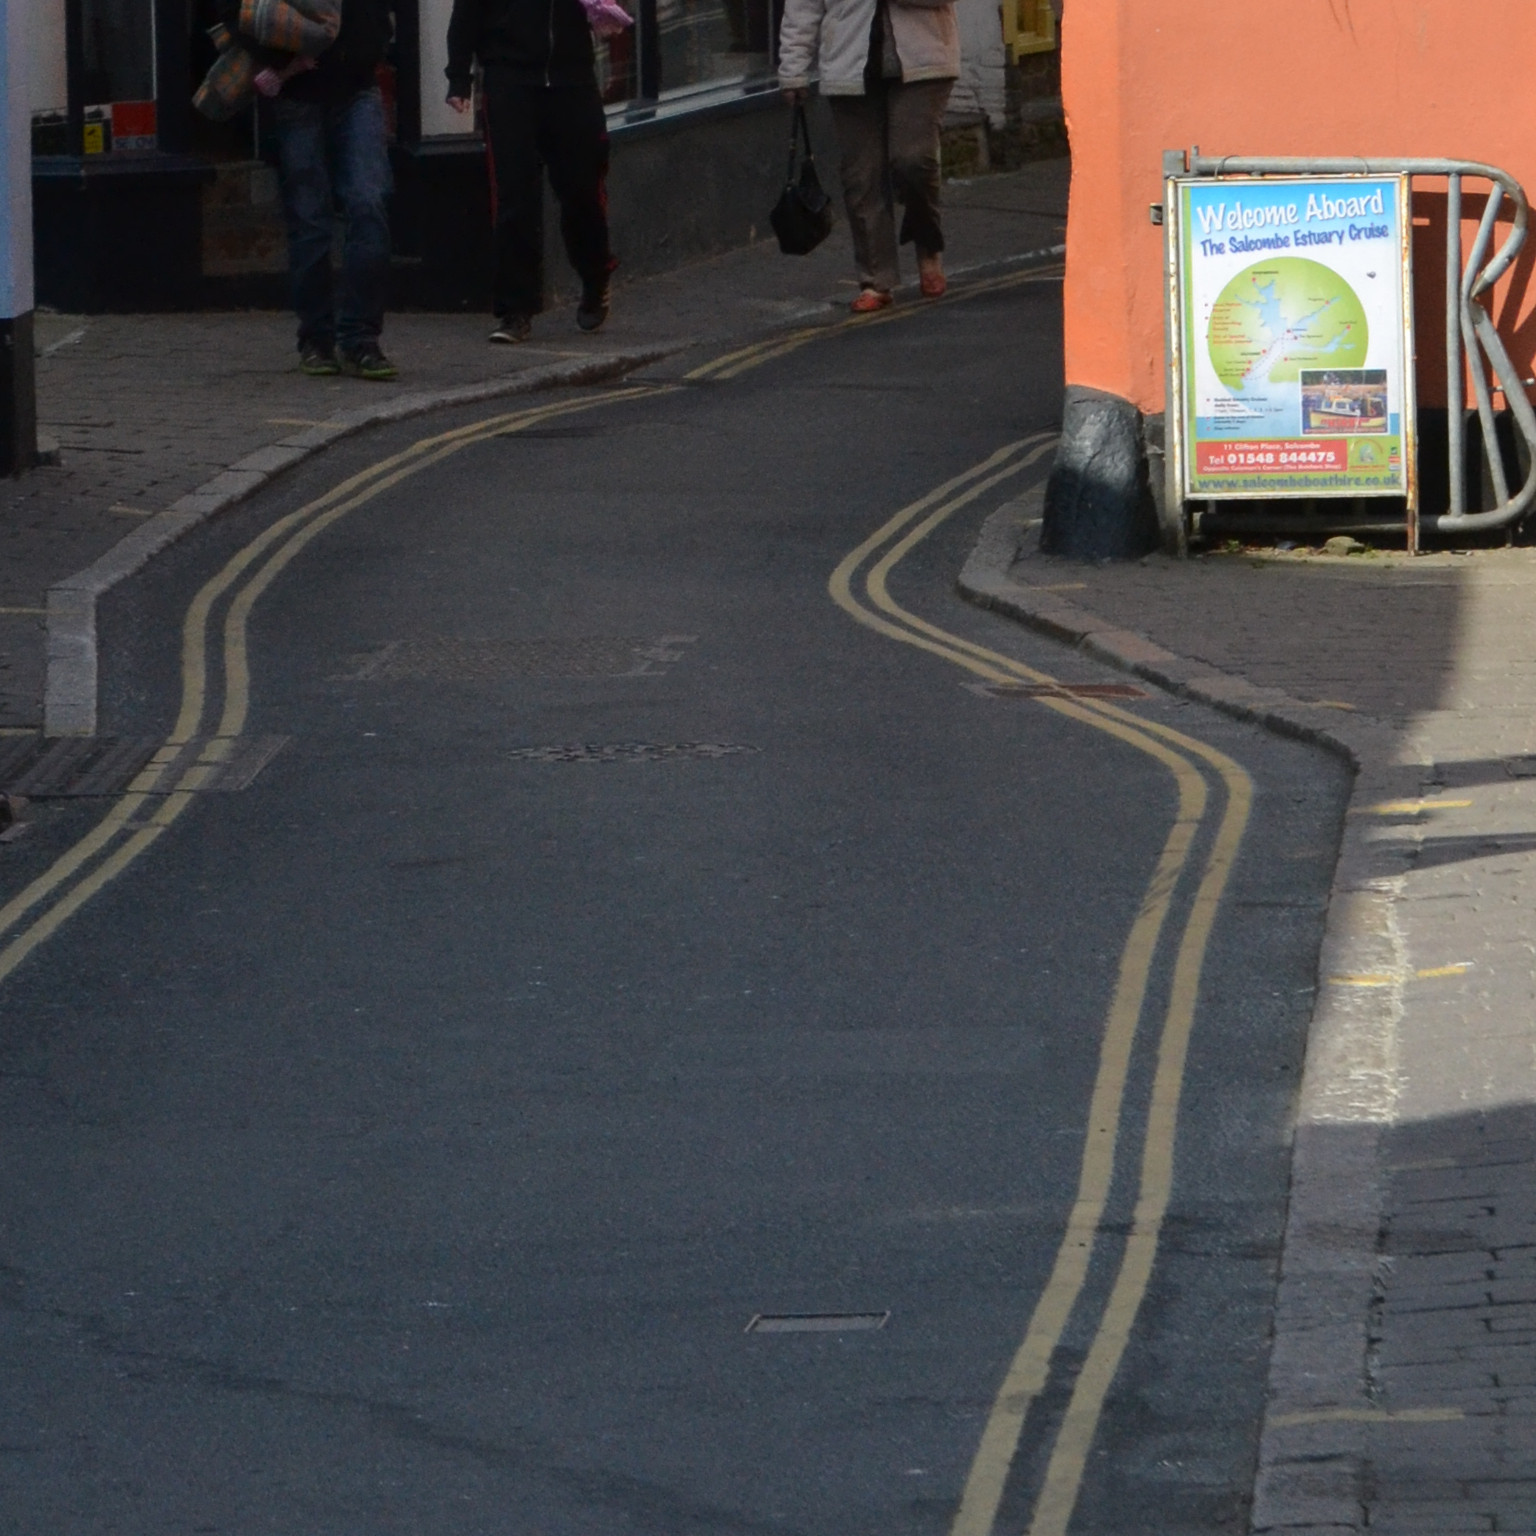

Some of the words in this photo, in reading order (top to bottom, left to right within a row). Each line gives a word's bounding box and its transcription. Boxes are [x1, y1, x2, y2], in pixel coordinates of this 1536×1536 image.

[1197, 202, 1298, 234] Welcome
[1306, 188, 1384, 221] Aboard
[1200, 240, 1225, 257] The
[1229, 233, 1290, 254] Salcombe
[1294, 228, 1345, 247] Estuary
[1349, 223, 1389, 240] Cruise
[1284, 441, 1321, 450] Salcombe
[1209, 455, 1225, 465] Tel
[1227, 452, 1275, 464] 01548
[1279, 451, 1336, 464] 844475
